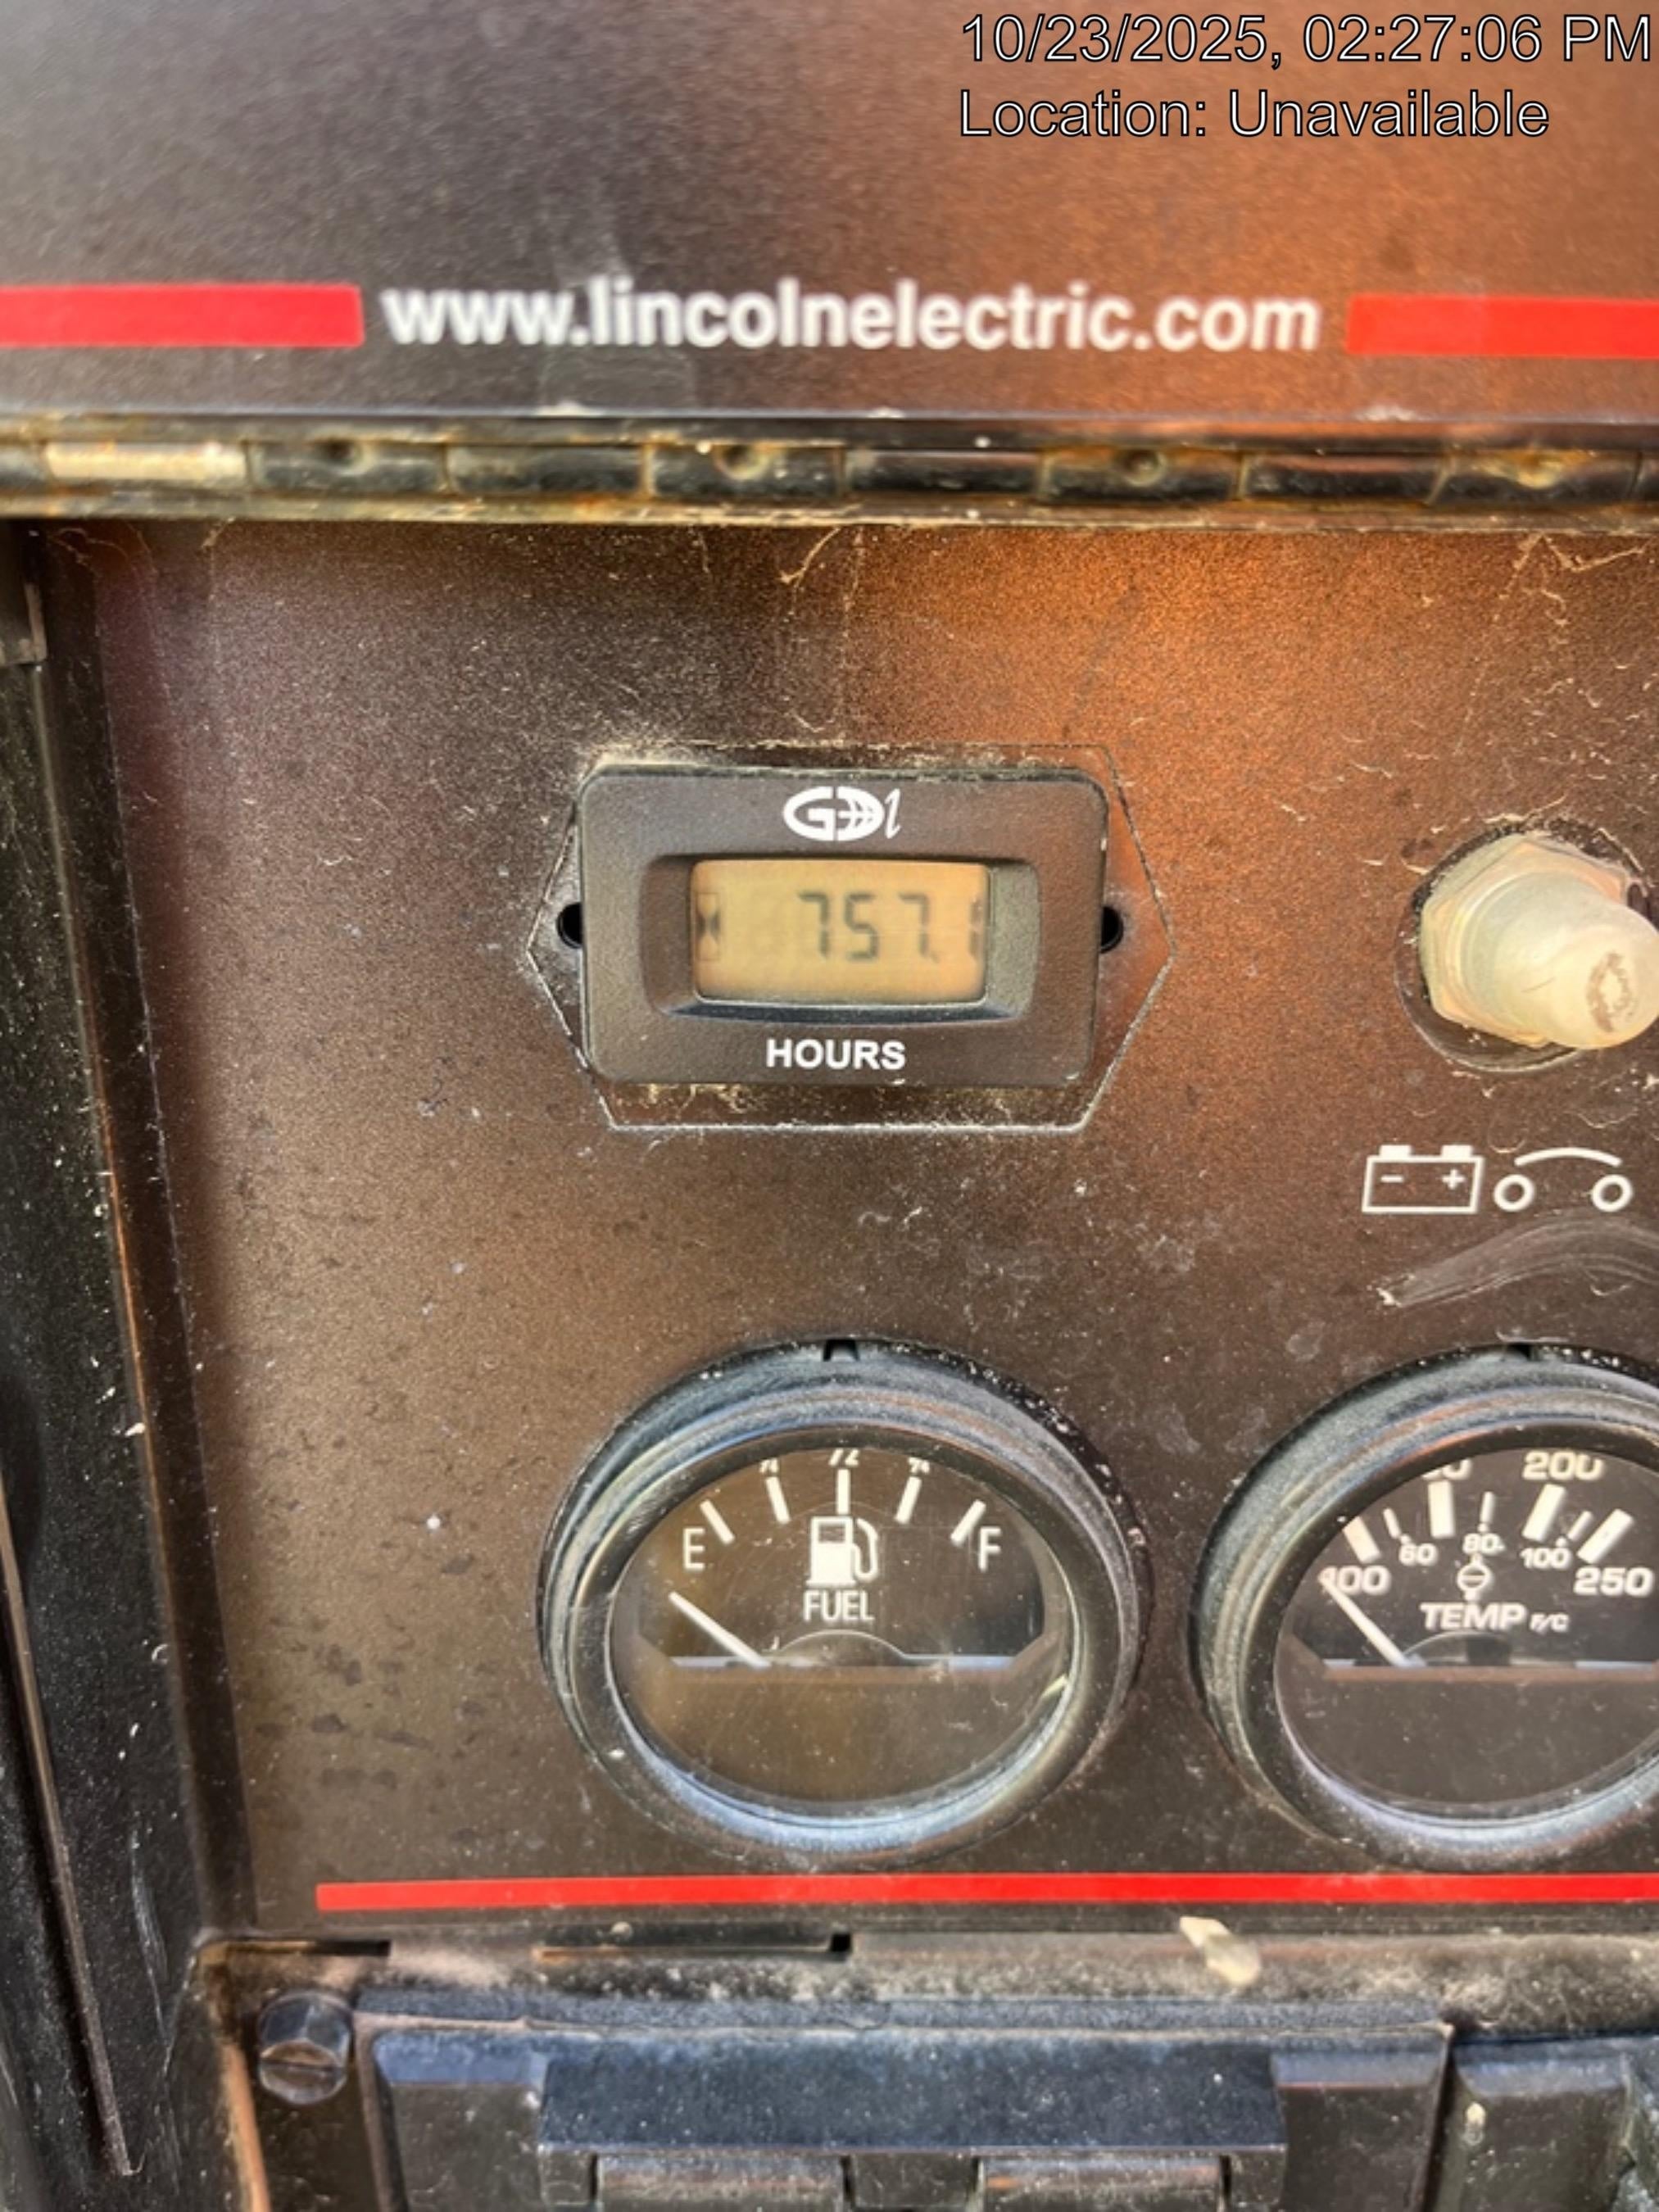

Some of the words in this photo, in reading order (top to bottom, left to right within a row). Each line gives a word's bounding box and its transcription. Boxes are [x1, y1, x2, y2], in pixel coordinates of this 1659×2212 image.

[379, 274, 1321, 352] www.lincolnelectric.com
[765, 1038, 906, 1071] HOURS
[1521, 1449, 1606, 1481] 200
[682, 1526, 705, 1571] E
[978, 1526, 1002, 1571] F
[1520, 1547, 1572, 1570] 100
[1573, 1566, 1655, 1597] 250
[803, 1589, 875, 1621] FUEL
[1420, 1601, 1527, 1632] TEMP
